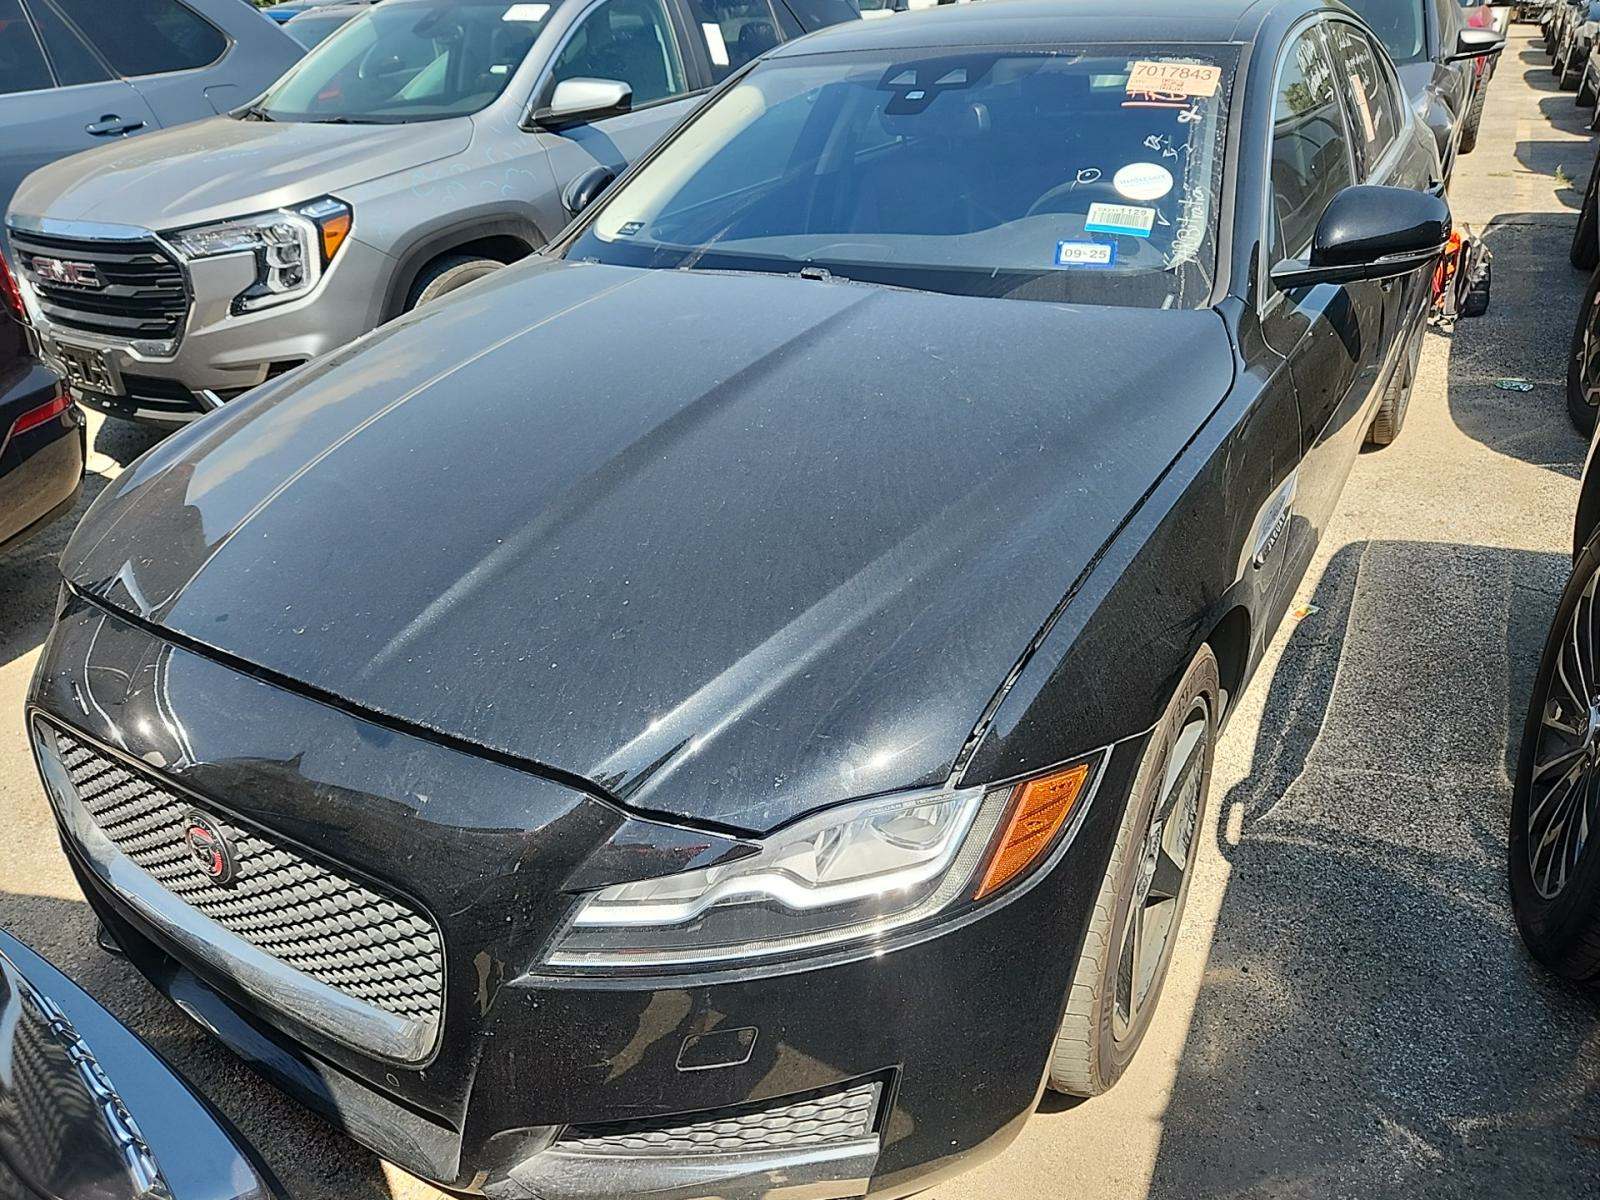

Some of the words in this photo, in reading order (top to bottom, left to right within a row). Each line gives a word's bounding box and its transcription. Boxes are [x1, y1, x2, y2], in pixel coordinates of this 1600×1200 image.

[1136, 65, 1213, 81] 7017843
[1064, 248, 1107, 260] 09-25
[31, 256, 101, 287] GMC
[1267, 512, 1286, 552] JAGUAR
